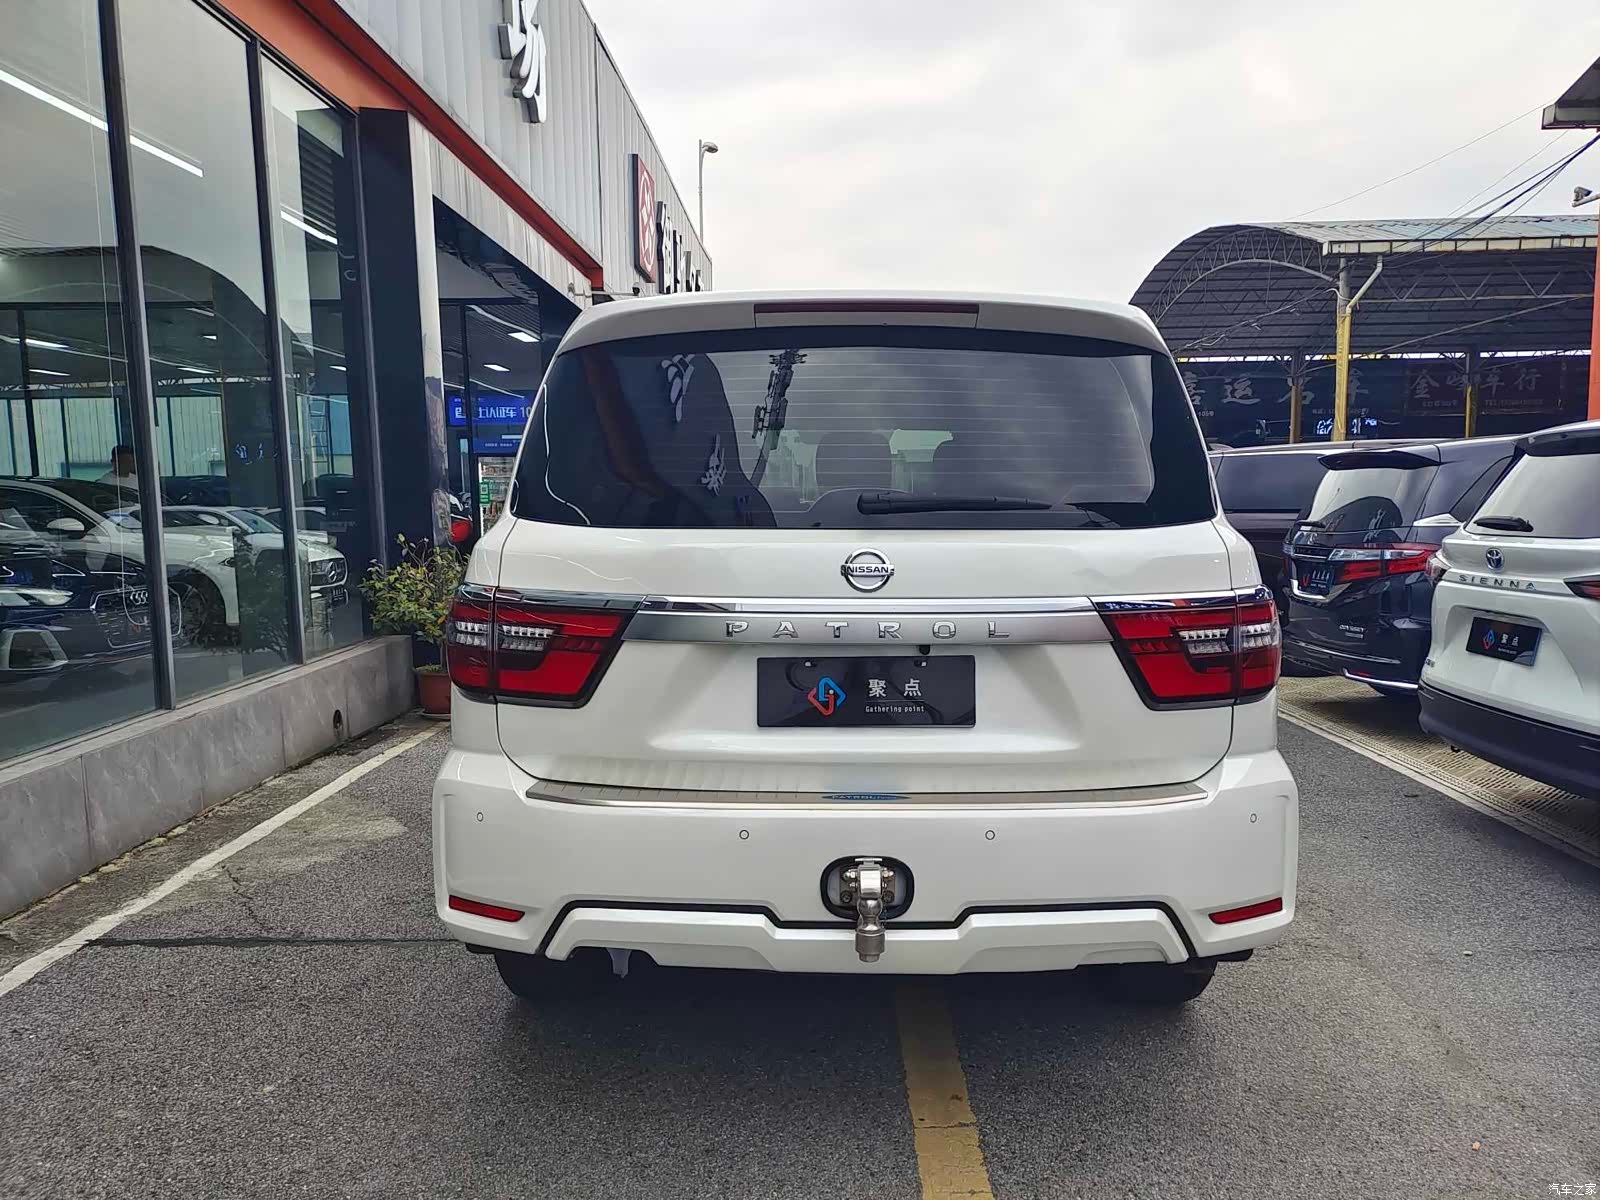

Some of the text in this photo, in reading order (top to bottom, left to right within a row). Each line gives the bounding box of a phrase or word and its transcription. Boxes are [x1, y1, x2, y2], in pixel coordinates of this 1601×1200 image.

[847, 565, 889, 574] NISSAN
[1458, 574, 1537, 591] SIENNA
[725, 620, 1010, 640] PATROL
[868, 678, 922, 698] 聚点
[865, 705, 925, 713] Gathering point
